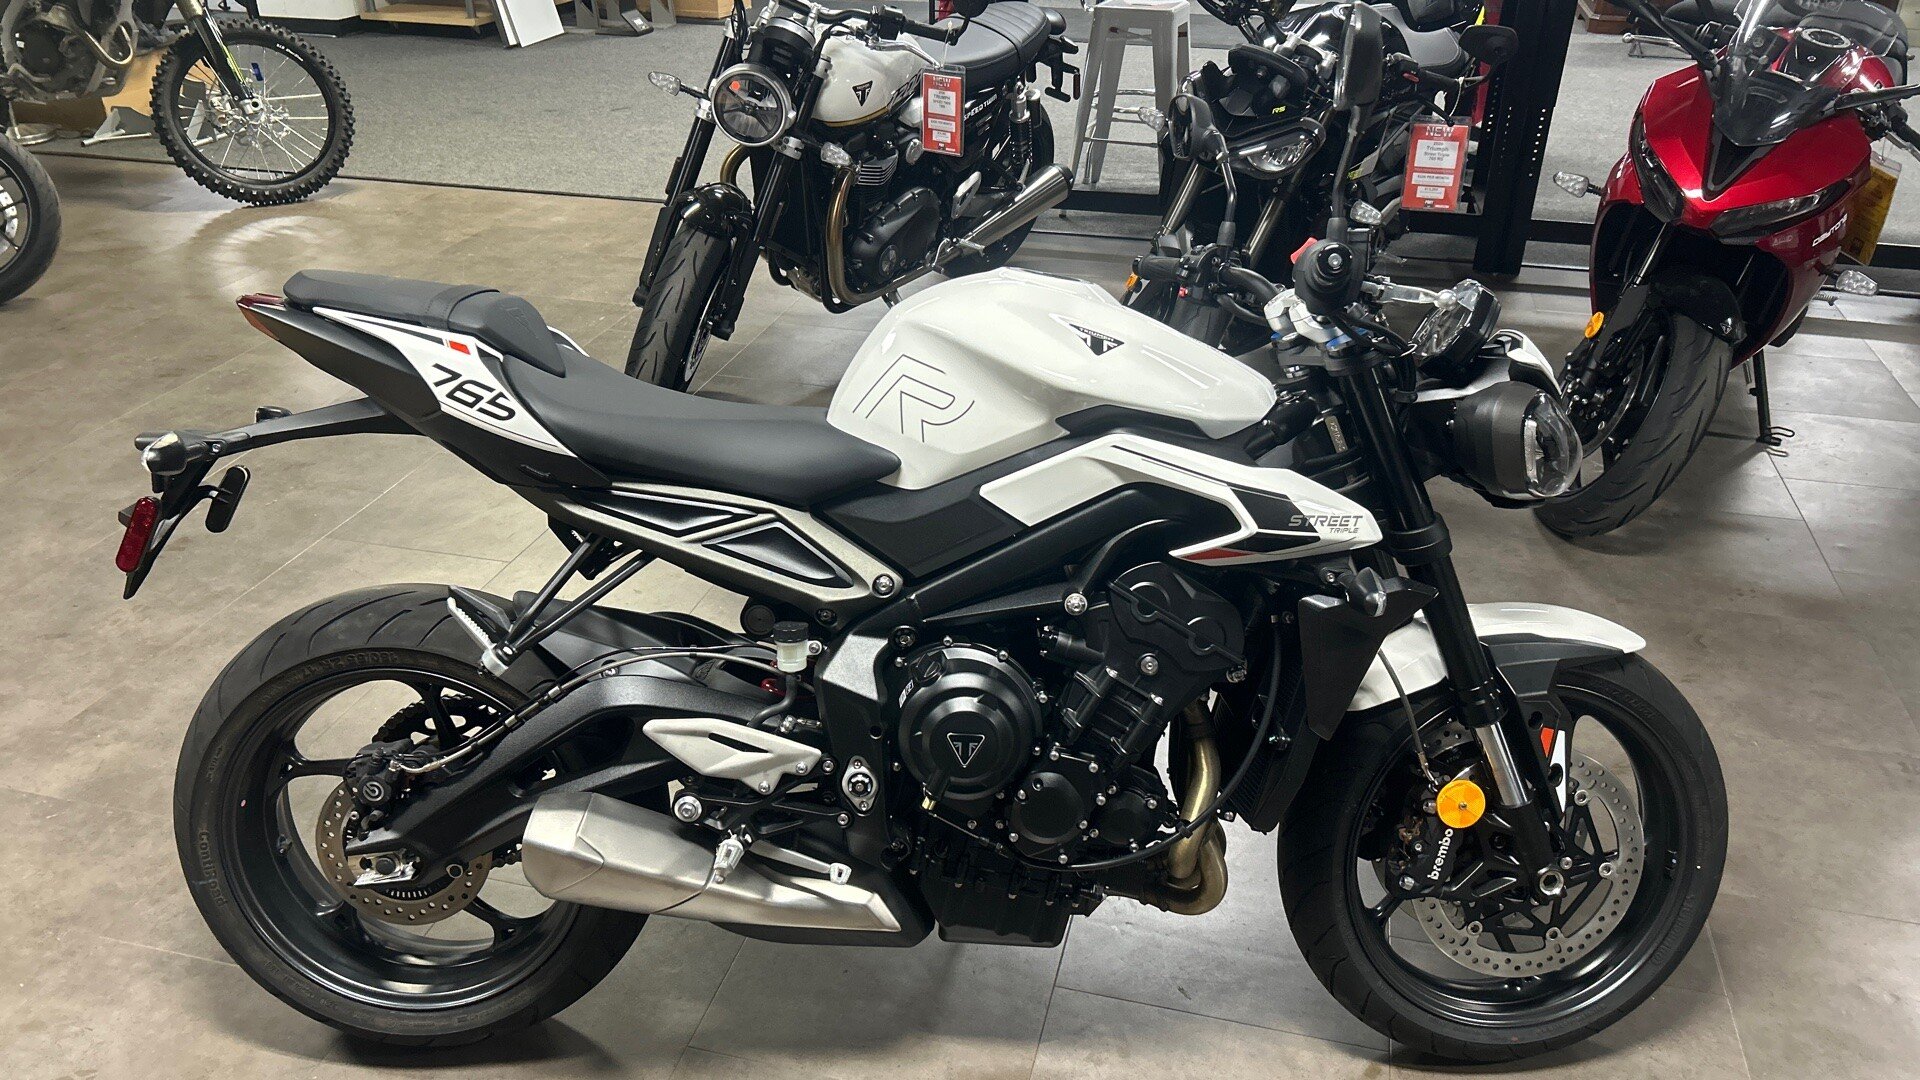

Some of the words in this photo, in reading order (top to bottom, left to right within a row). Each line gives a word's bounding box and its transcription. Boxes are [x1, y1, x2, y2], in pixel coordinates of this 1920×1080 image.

[1425, 126, 1455, 137] NEW
[432, 363, 516, 421] 765
[1288, 514, 1363, 527] STREET
[1427, 828, 1454, 880] brembo
